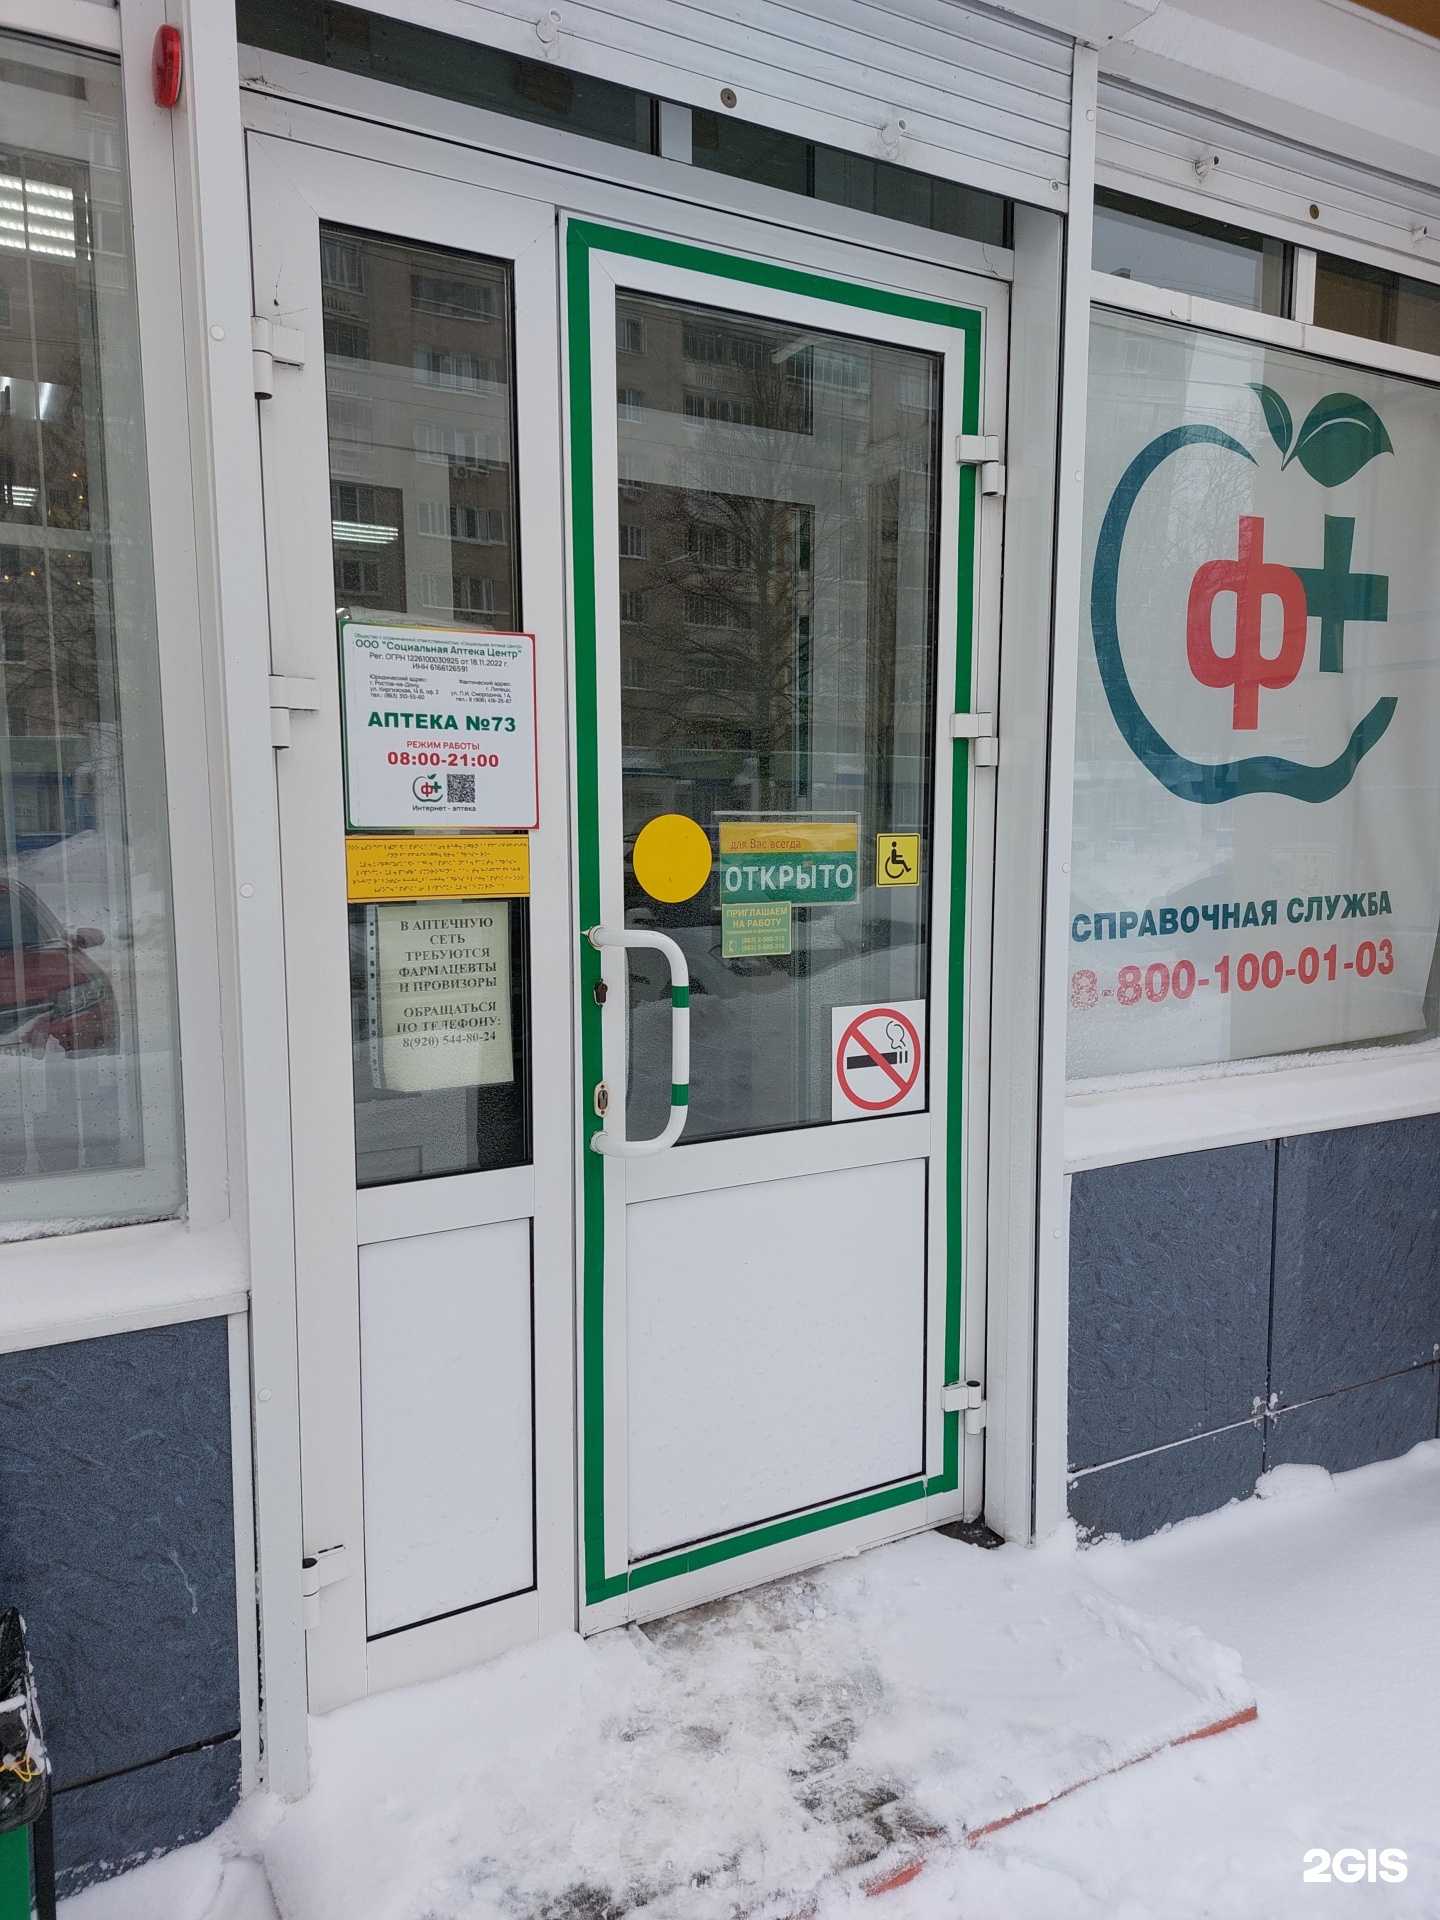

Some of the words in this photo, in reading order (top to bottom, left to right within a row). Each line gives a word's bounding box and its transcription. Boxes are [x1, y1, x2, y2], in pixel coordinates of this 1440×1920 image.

[355, 639, 379, 649] ООО
[382, 640, 448, 654] "Социальная
[450, 646, 485, 656] Аптека
[488, 648, 522, 660] Центр"
[385, 653, 406, 661] ОГРН
[470, 658, 502, 667] 18.11.2022
[368, 711, 458, 730] АПТЕКА
[466, 716, 516, 732] №73
[407, 740, 441, 749] РЕЖИМ
[443, 742, 480, 750] РАБОТЫ
[387, 751, 499, 767] 08:00-21:00
[412, 805, 446, 813] Интернет
[730, 841, 747, 850] для
[750, 839, 767, 849] Вас
[725, 864, 853, 892] ОТКРЫТО
[400, 920, 409, 931] В
[413, 917, 494, 931] АПТЕЧНУЮ
[1071, 899, 1278, 942] СПРАВОЧНАЯ
[1286, 890, 1393, 924] СЛУЖБА
[430, 934, 466, 945] СЕТЬ
[405, 947, 490, 962] ТРЕБУЮТСЯ
[399, 962, 497, 977] ФАРМАЦЕВТЫ
[1070, 938, 1395, 1010] 8-800-100-01-03
[400, 982, 409, 993] И
[413, 977, 497, 992] ПРОВИЗОРЫ
[403, 1001, 496, 1017] ОБРАЩАТЬСЯ
[397, 1022, 418, 1033] ПО
[423, 1016, 502, 1032] ТЕЛЕФОНУ:
